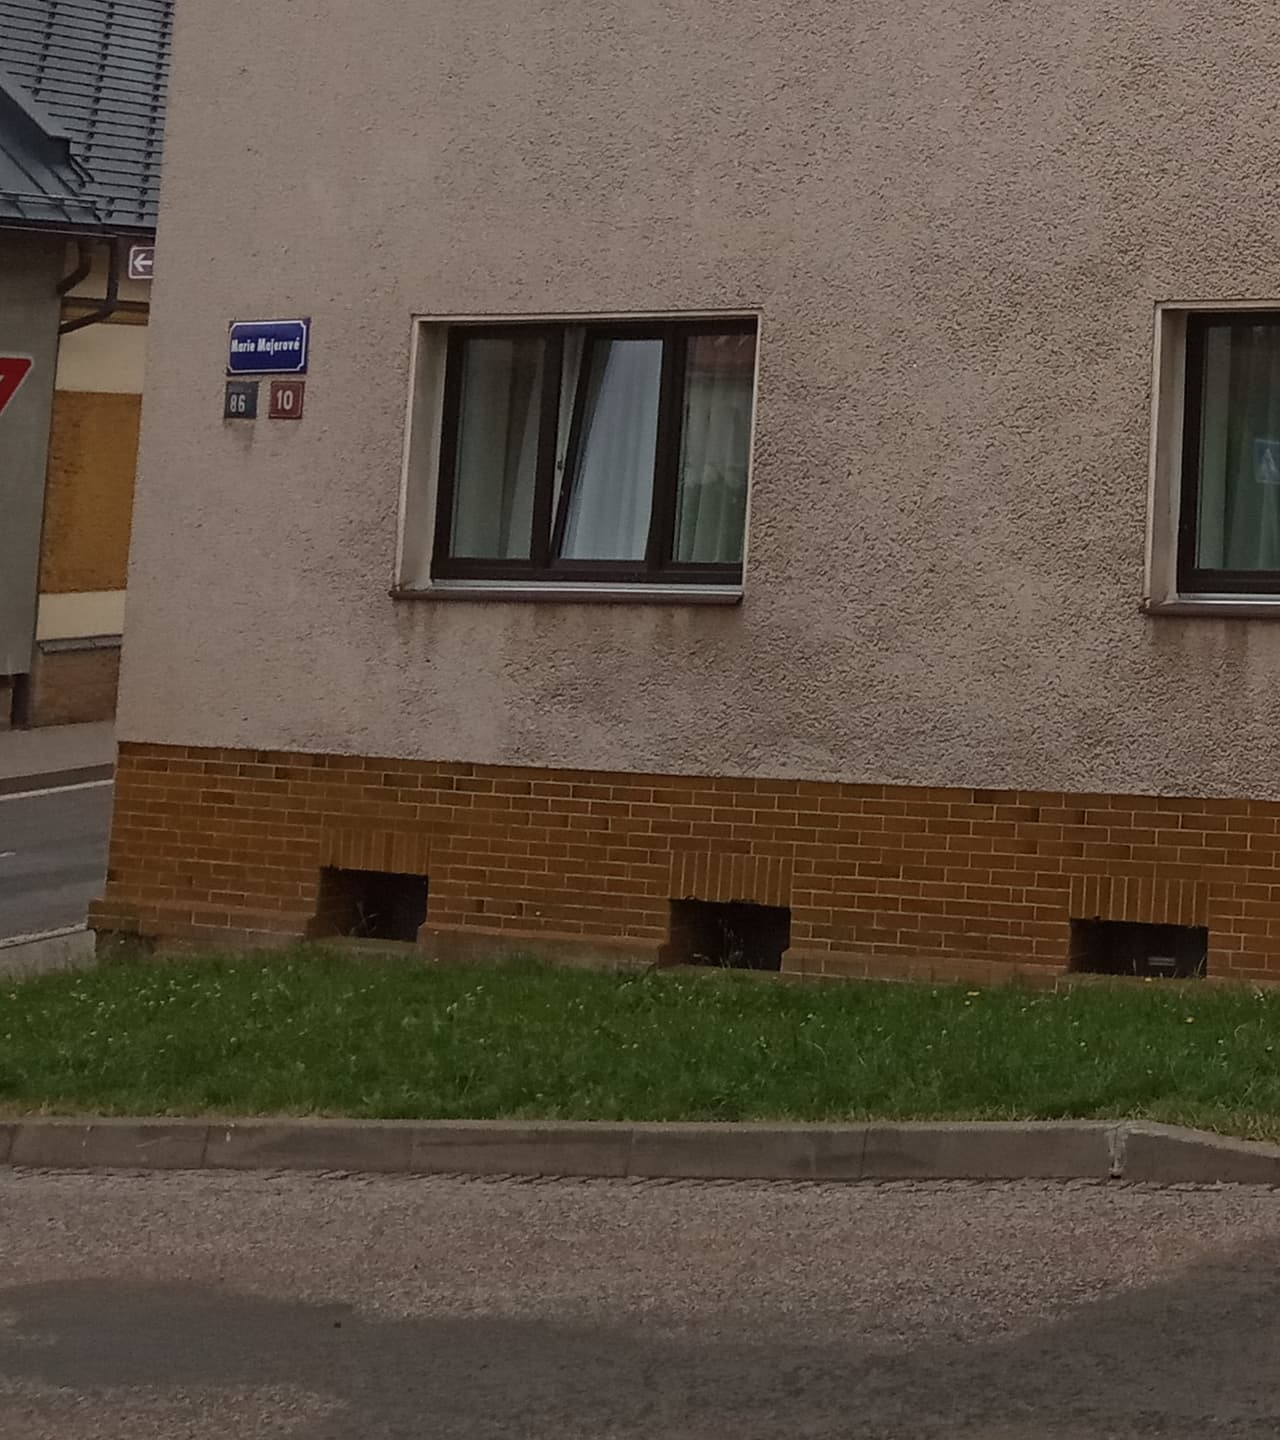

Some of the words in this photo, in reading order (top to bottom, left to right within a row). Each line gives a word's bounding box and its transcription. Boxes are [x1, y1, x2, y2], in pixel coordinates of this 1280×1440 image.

[231, 339, 255, 352] Marie
[257, 337, 300, 356] Majerové
[230, 394, 246, 413] 86
[276, 390, 293, 410] 10
